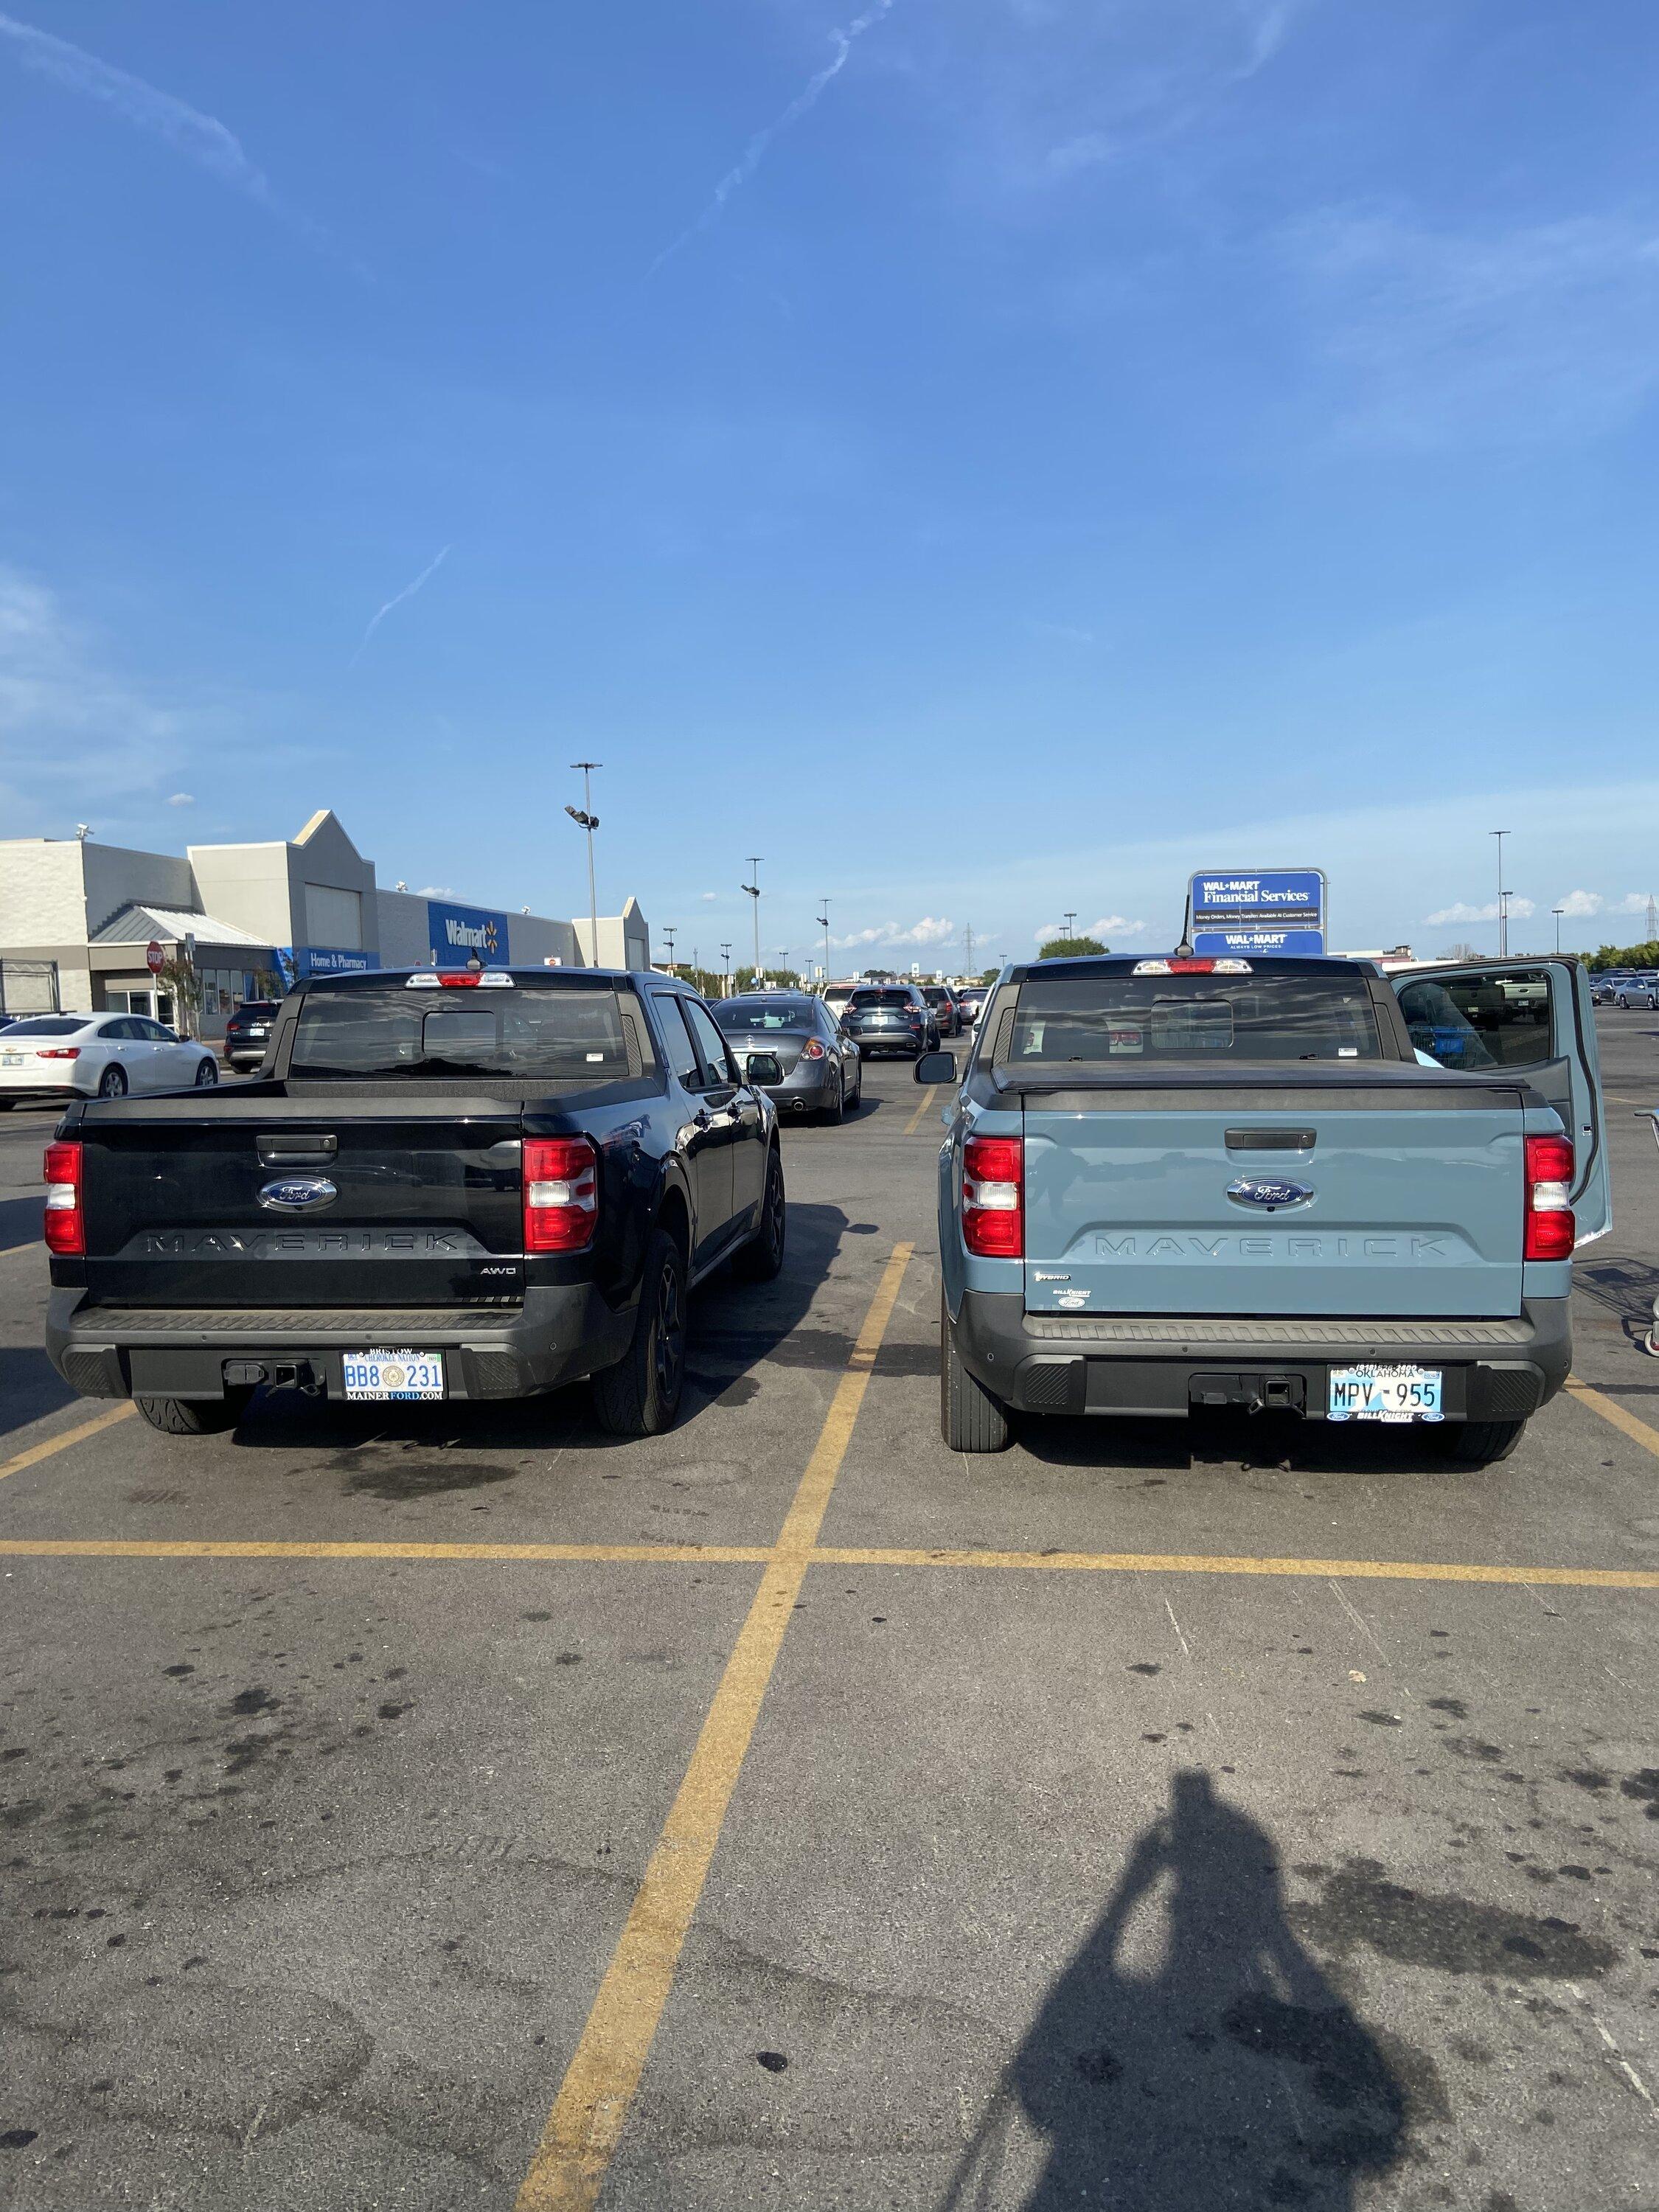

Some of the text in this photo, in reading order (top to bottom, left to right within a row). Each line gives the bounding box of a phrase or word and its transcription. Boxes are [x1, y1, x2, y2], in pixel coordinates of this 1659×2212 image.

[1203, 889, 1309, 903] Financial Services
[445, 919, 487, 949] Walmart
[147, 951, 163, 964] STOP
[310, 953, 367, 970] Home & Pharmacy
[279, 1186, 311, 1200] Ford
[1254, 1185, 1291, 1201] Ford
[147, 1234, 458, 1252] MAVERICK
[1095, 1237, 1447, 1256] MAVERICK
[365, 1354, 420, 1363] CHEROKEE NATION
[345, 1365, 380, 1387] BB8
[407, 1365, 442, 1387] 231
[1355, 1369, 1415, 1379] OKLAHOMA
[347, 1391, 443, 1400] MAINERFORD.COM
[1334, 1382, 1435, 1407] MPV 955
